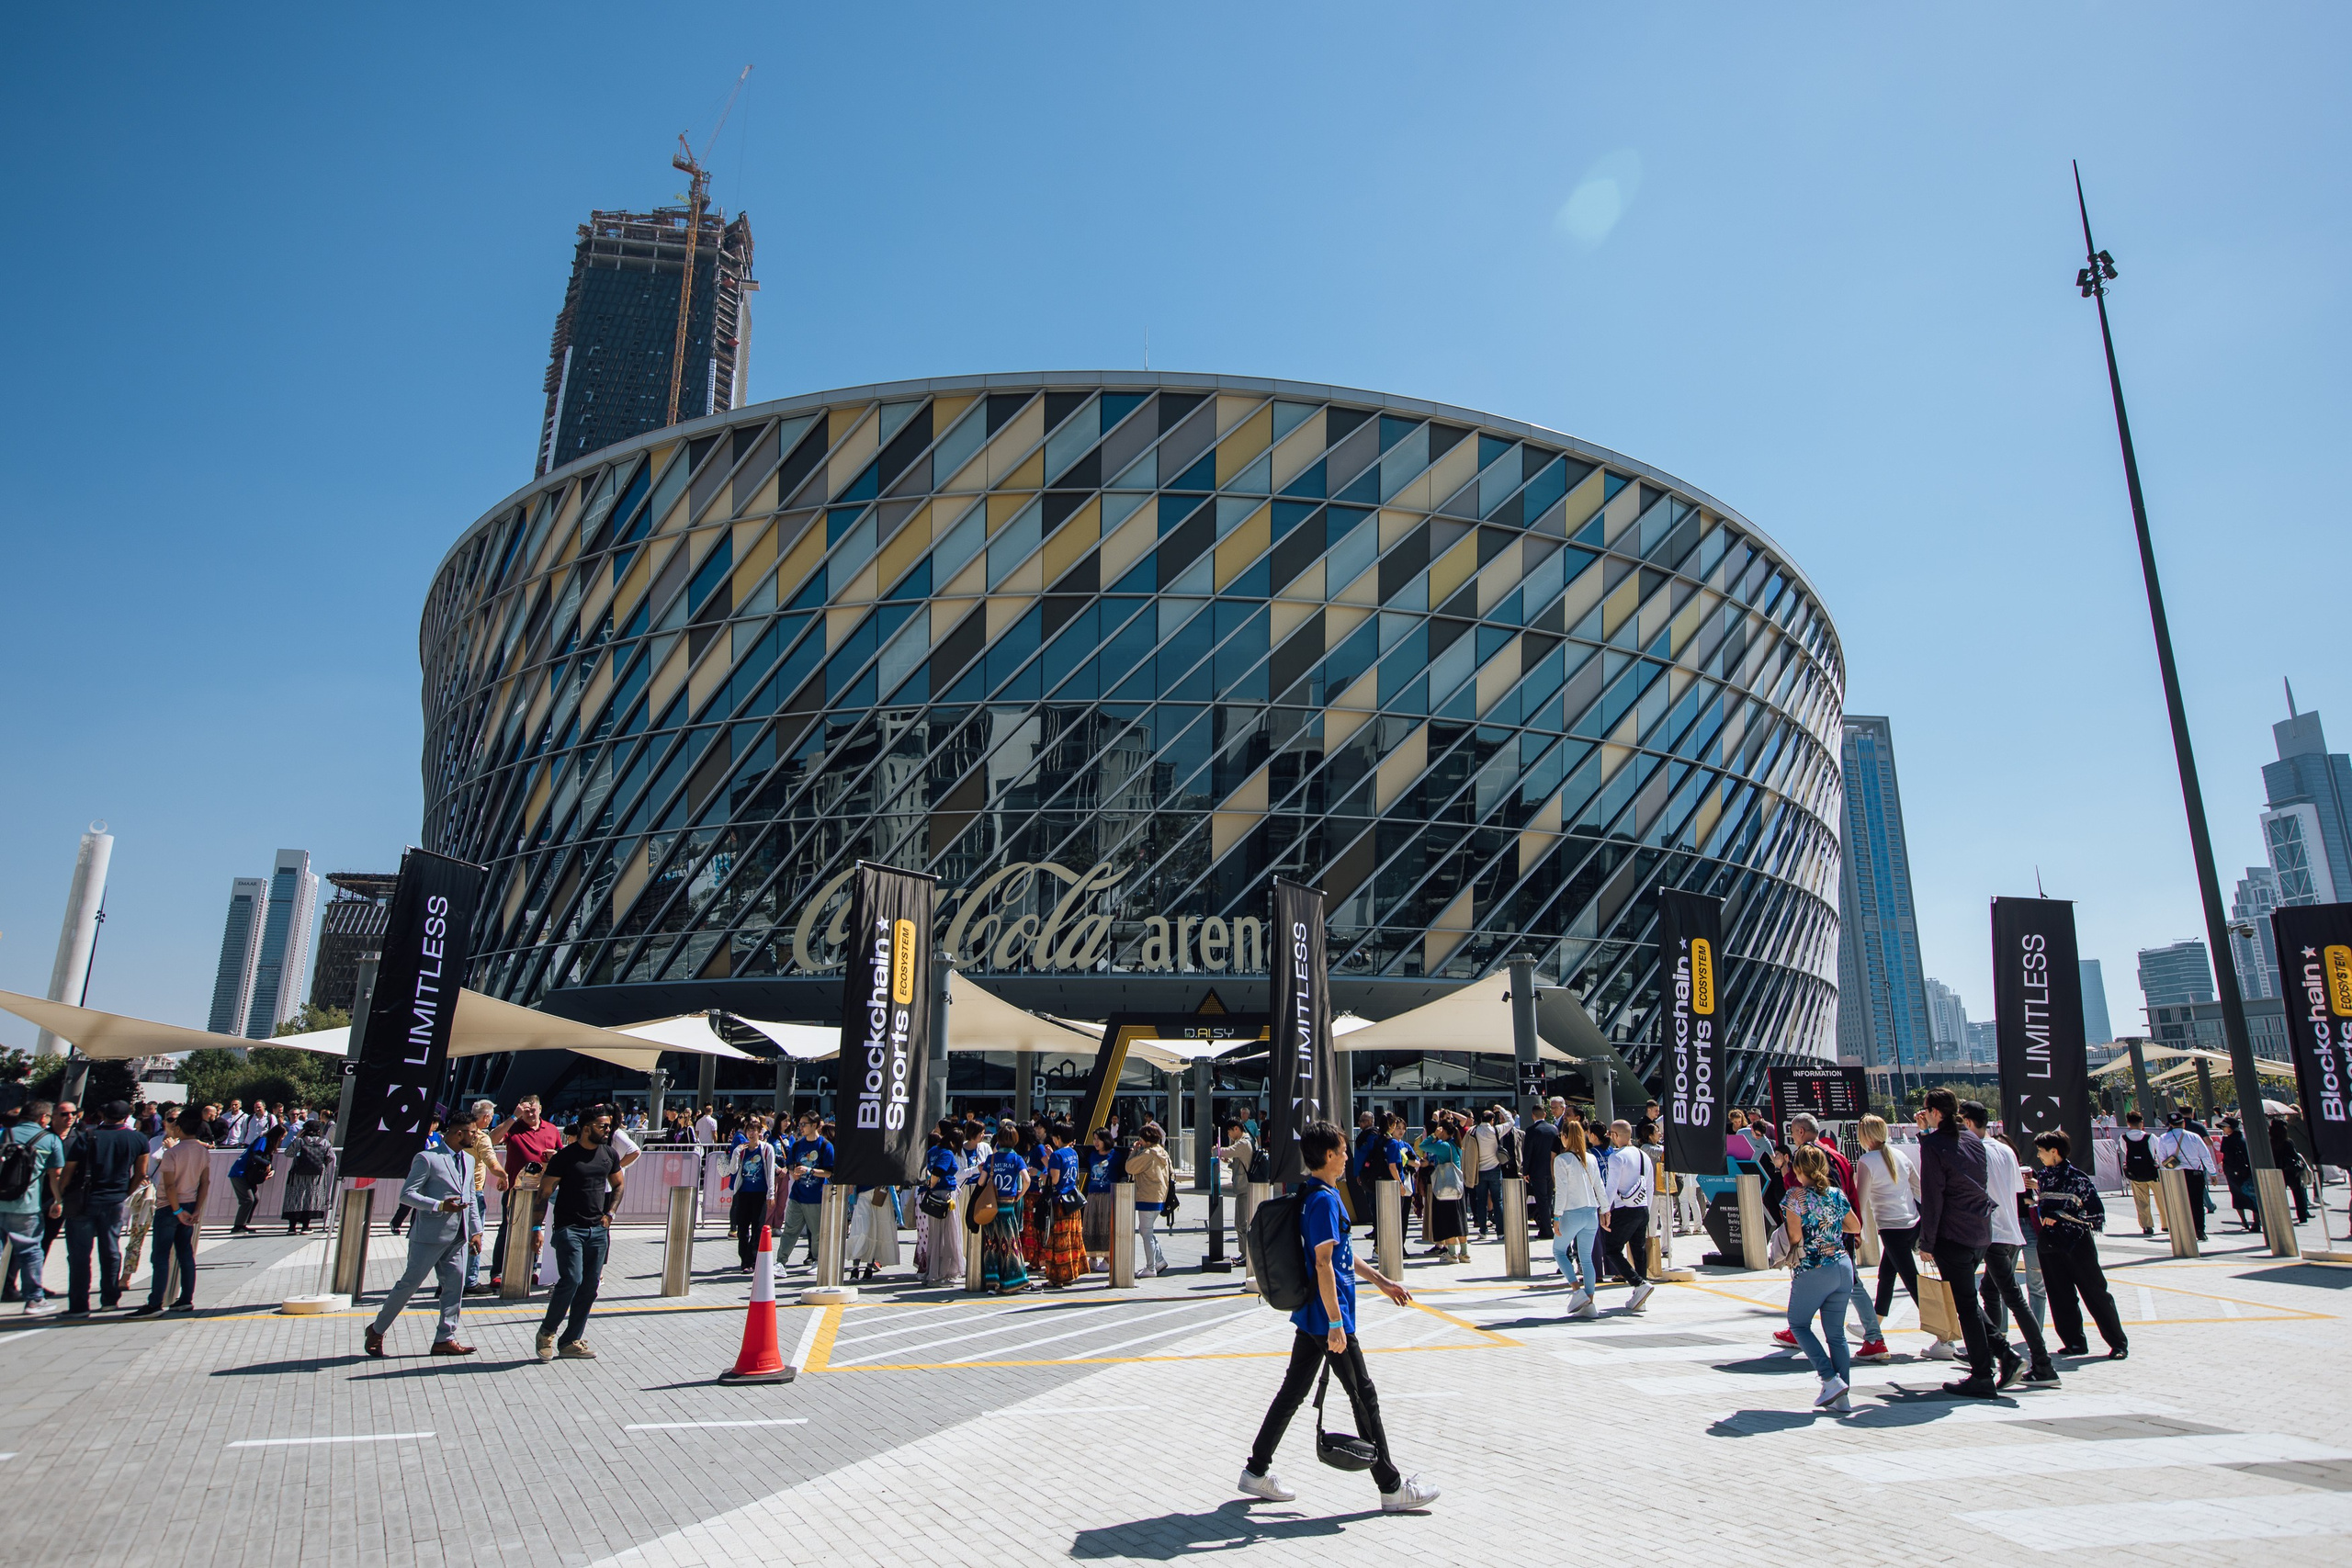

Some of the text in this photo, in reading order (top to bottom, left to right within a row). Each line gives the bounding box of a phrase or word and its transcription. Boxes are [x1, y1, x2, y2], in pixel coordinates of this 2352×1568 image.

[403, 895, 448, 1066] LIMITLESS
[1141, 915, 1272, 971] aren
[1293, 921, 1312, 1079] LIMITLESS
[2021, 933, 2052, 1078] LIMITLESS
[2333, 951, 2352, 1011] ECOSYSTEM
[345, 1065, 355, 1075] C
[818, 1076, 828, 1097] C
[857, 938, 890, 1129] Blockchain
[885, 927, 910, 1131] Sports ECOSYSTEM
[1034, 1076, 1046, 1098] B
[1528, 1084, 1539, 1095] A
[1672, 955, 1690, 1125] Blockchain
[1690, 944, 1714, 1128] Sports ECOSYSTEM
[2301, 964, 2346, 1122] Blockchain
